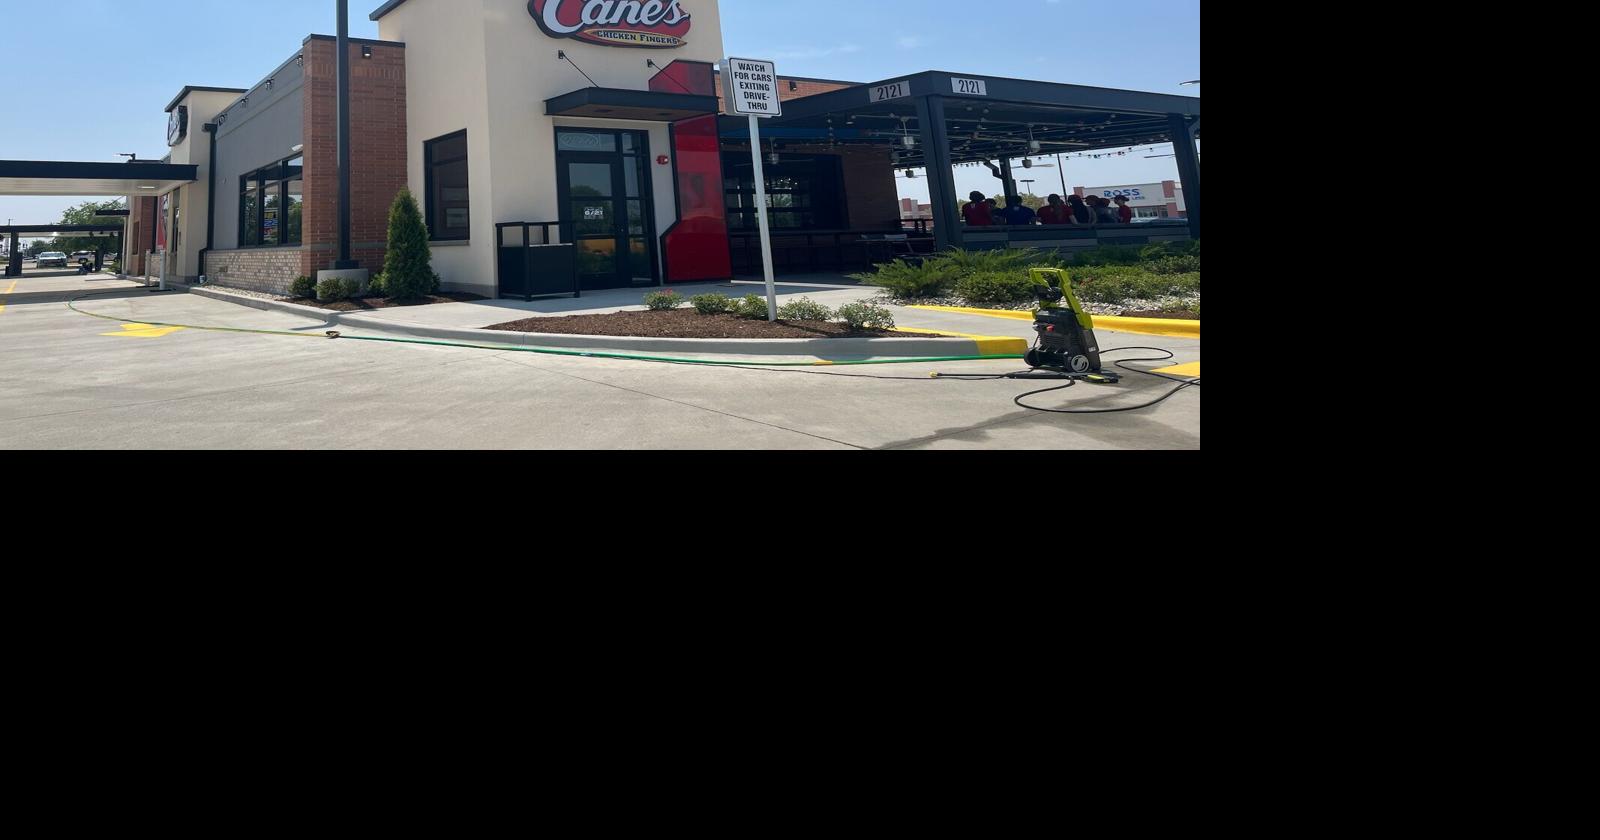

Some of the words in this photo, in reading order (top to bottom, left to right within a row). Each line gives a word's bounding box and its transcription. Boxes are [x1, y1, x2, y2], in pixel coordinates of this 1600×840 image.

[598, 31, 636, 41] CHICKEN
[640, 34, 678, 44] FINGERS
[737, 62, 766, 72] WATCH
[734, 71, 750, 80] FOR
[751, 73, 772, 82] CARS
[740, 81, 770, 91] EXITING
[958, 79, 980, 94] 2121
[743, 91, 771, 101] DRIVE-
[877, 83, 903, 101] 2121
[747, 101, 768, 111] THRU
[1103, 188, 1140, 198] ROSS
